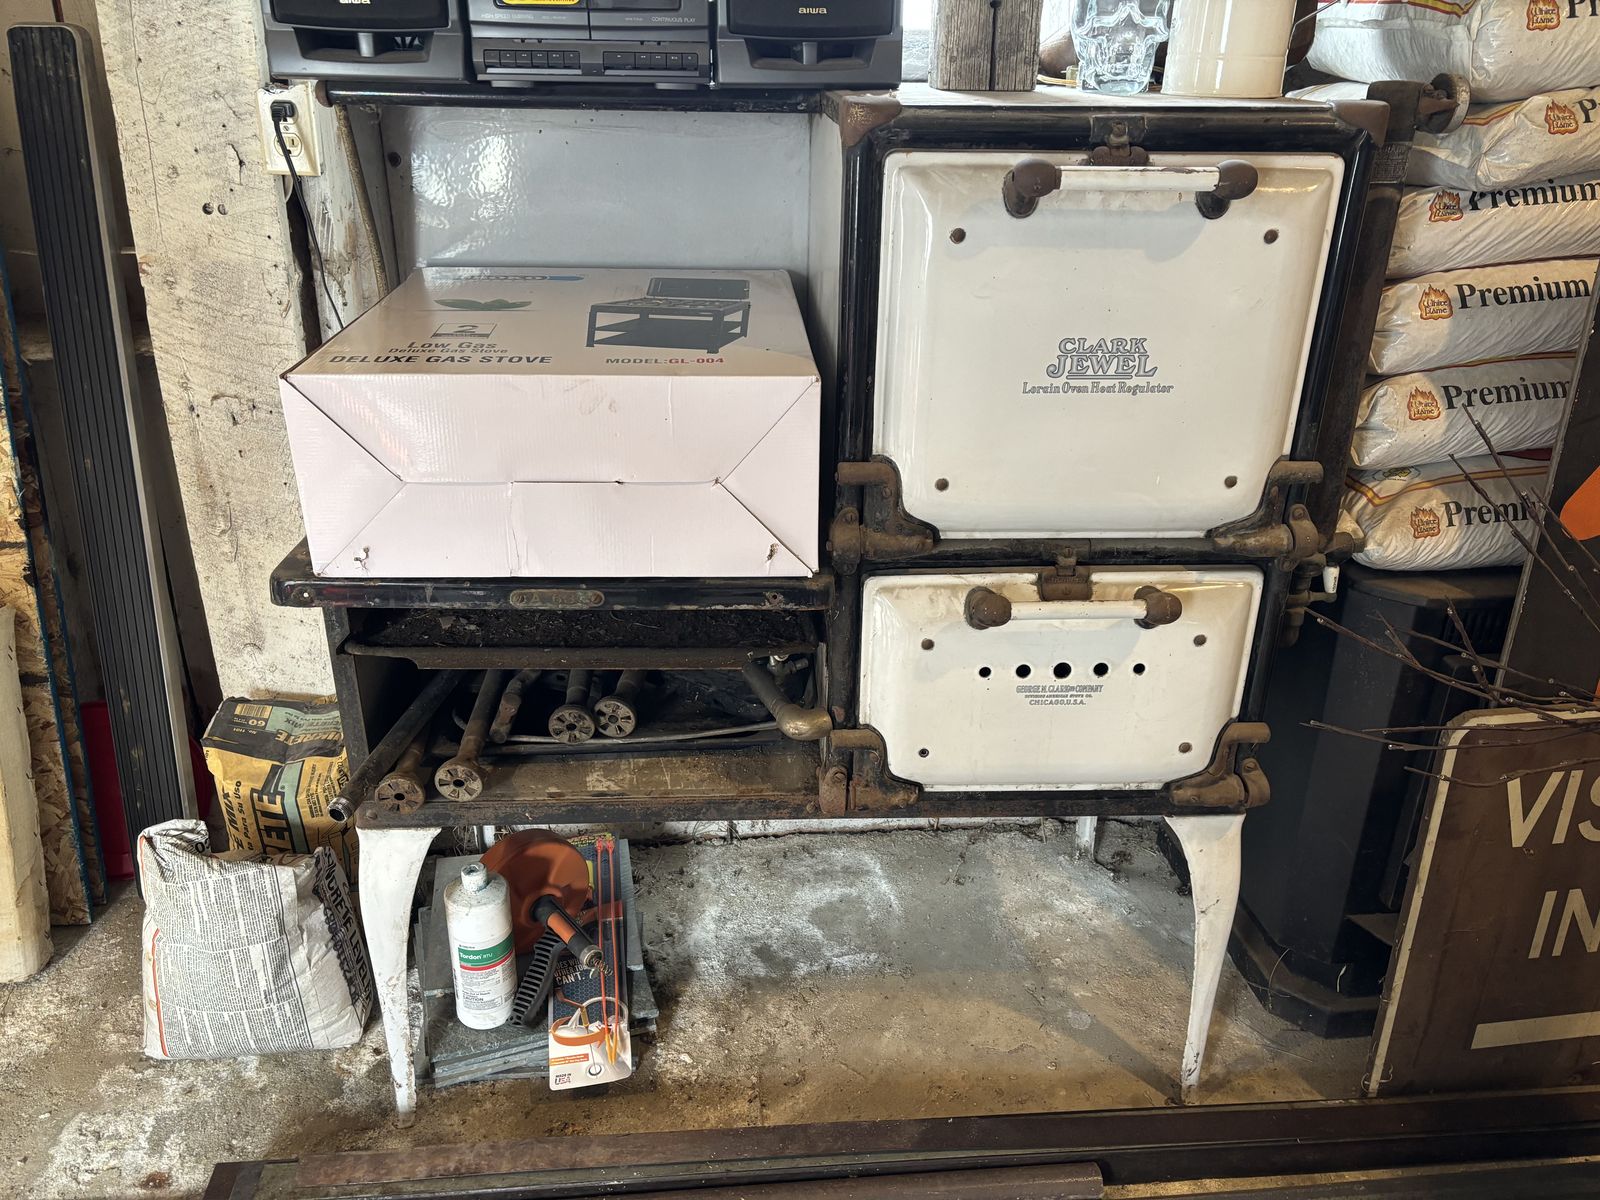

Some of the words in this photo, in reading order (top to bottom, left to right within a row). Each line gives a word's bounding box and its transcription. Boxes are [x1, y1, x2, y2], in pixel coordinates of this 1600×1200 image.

[1455, 276, 1592, 310] Premium
[455, 325, 479, 333] 2
[407, 341, 452, 349] Low
[457, 341, 497, 349] Gas
[1058, 337, 1148, 354] CLARK
[328, 355, 420, 364] DELUXE
[425, 355, 470, 364] GAS
[479, 355, 552, 364] STOVE
[1046, 354, 1158, 379] JEWEL
[1022, 382, 1061, 394] Lorain
[1061, 382, 1089, 394] Oven
[1090, 382, 1116, 394] Heat
[1117, 382, 1175, 396] Regulator
[1441, 500, 1537, 528] Premi
[1016, 685, 1041, 694] GEORGE
[248, 719, 266, 727] 60
[233, 780, 242, 799] Uso
[237, 802, 246, 815] Su
[241, 817, 251, 839] Para
[1529, 889, 1600, 959] IN
[459, 952, 482, 960] Tordon
[555, 971, 586, 985] CAN'T.
